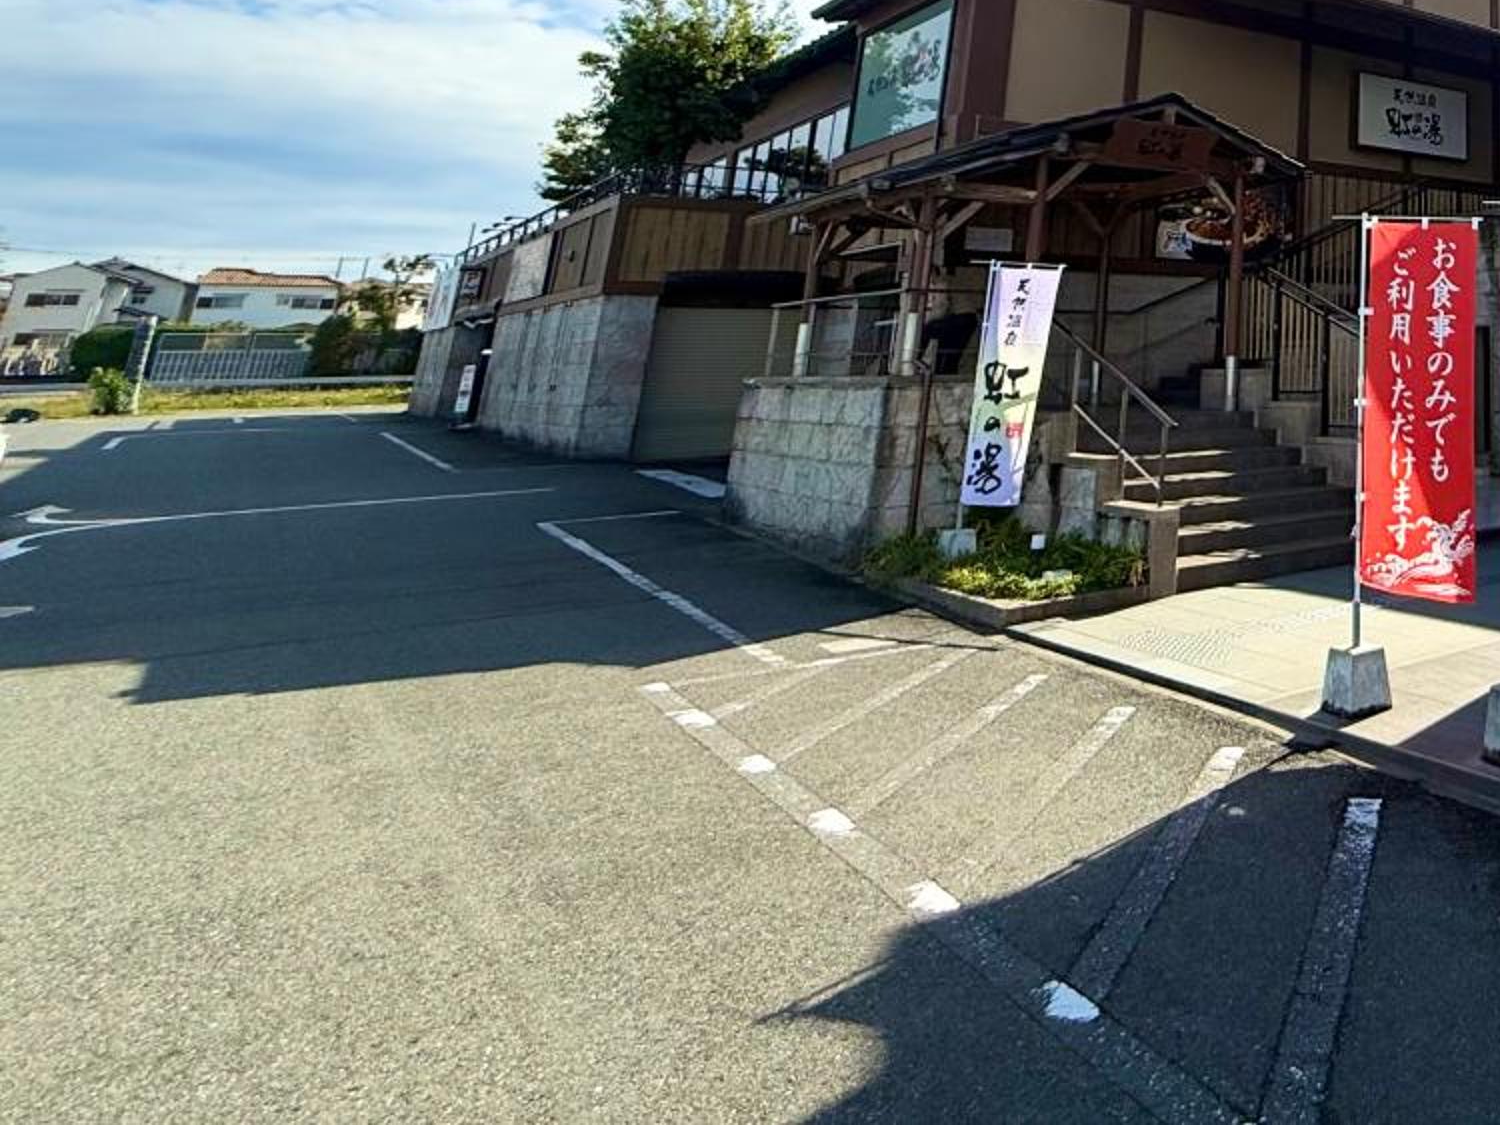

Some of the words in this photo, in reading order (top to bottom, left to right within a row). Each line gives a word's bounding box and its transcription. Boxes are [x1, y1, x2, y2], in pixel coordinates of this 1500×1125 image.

[1386, 246, 1417, 551] ご利用いただけます
[1425, 238, 1460, 483] お食事のみでも
